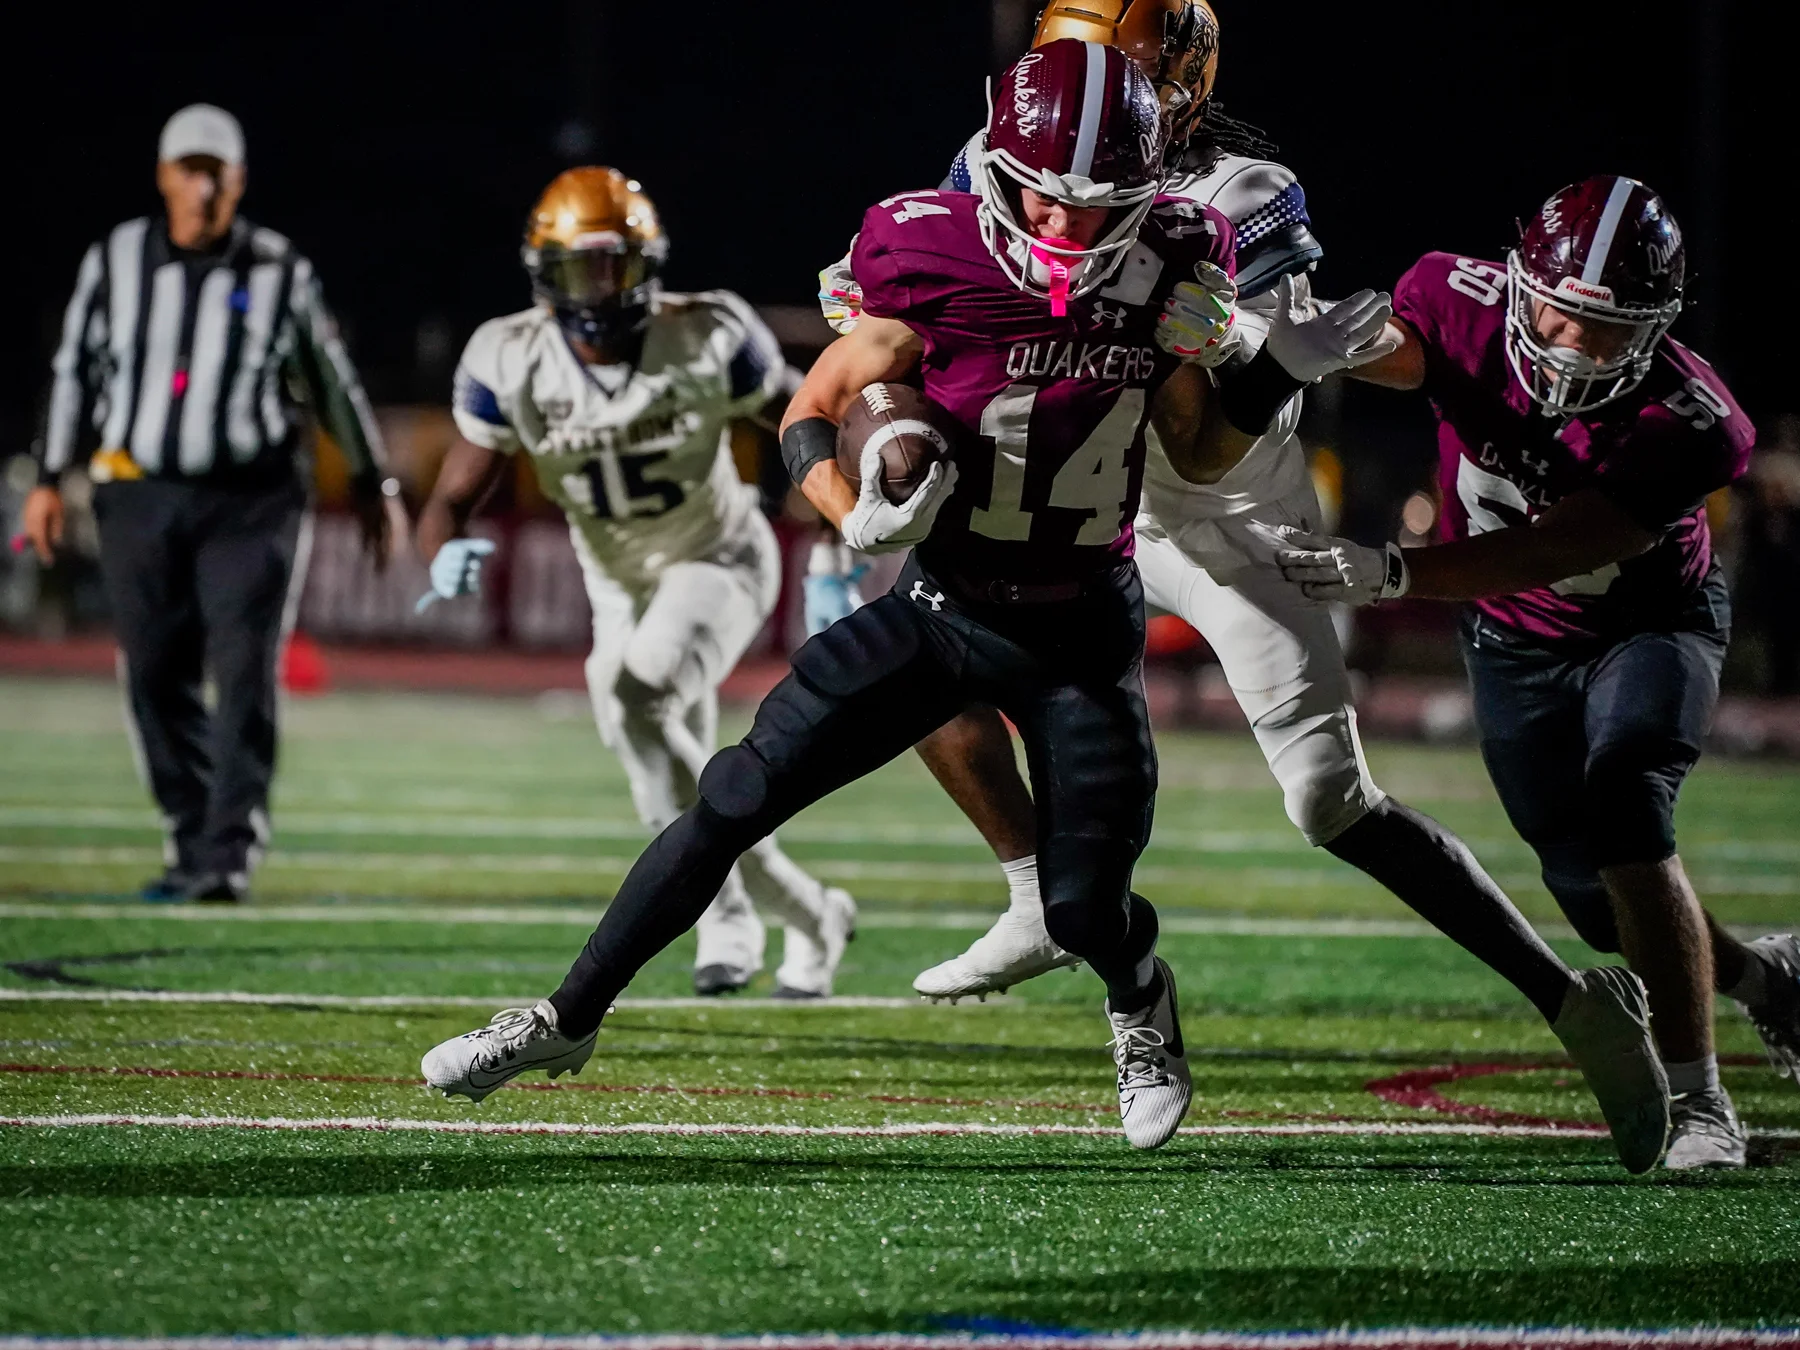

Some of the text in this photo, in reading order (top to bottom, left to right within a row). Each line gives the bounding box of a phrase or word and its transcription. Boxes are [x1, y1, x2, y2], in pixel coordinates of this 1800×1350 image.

[1009, 53, 1044, 138] Quakers
[878, 191, 952, 224] 14
[1447, 257, 1508, 306] 50
[1565, 281, 1611, 301] Riddell
[1006, 342, 1154, 379] QUAKERS
[1662, 376, 1731, 430] 50
[578, 451, 687, 519] 15
[969, 384, 1145, 546] 14
